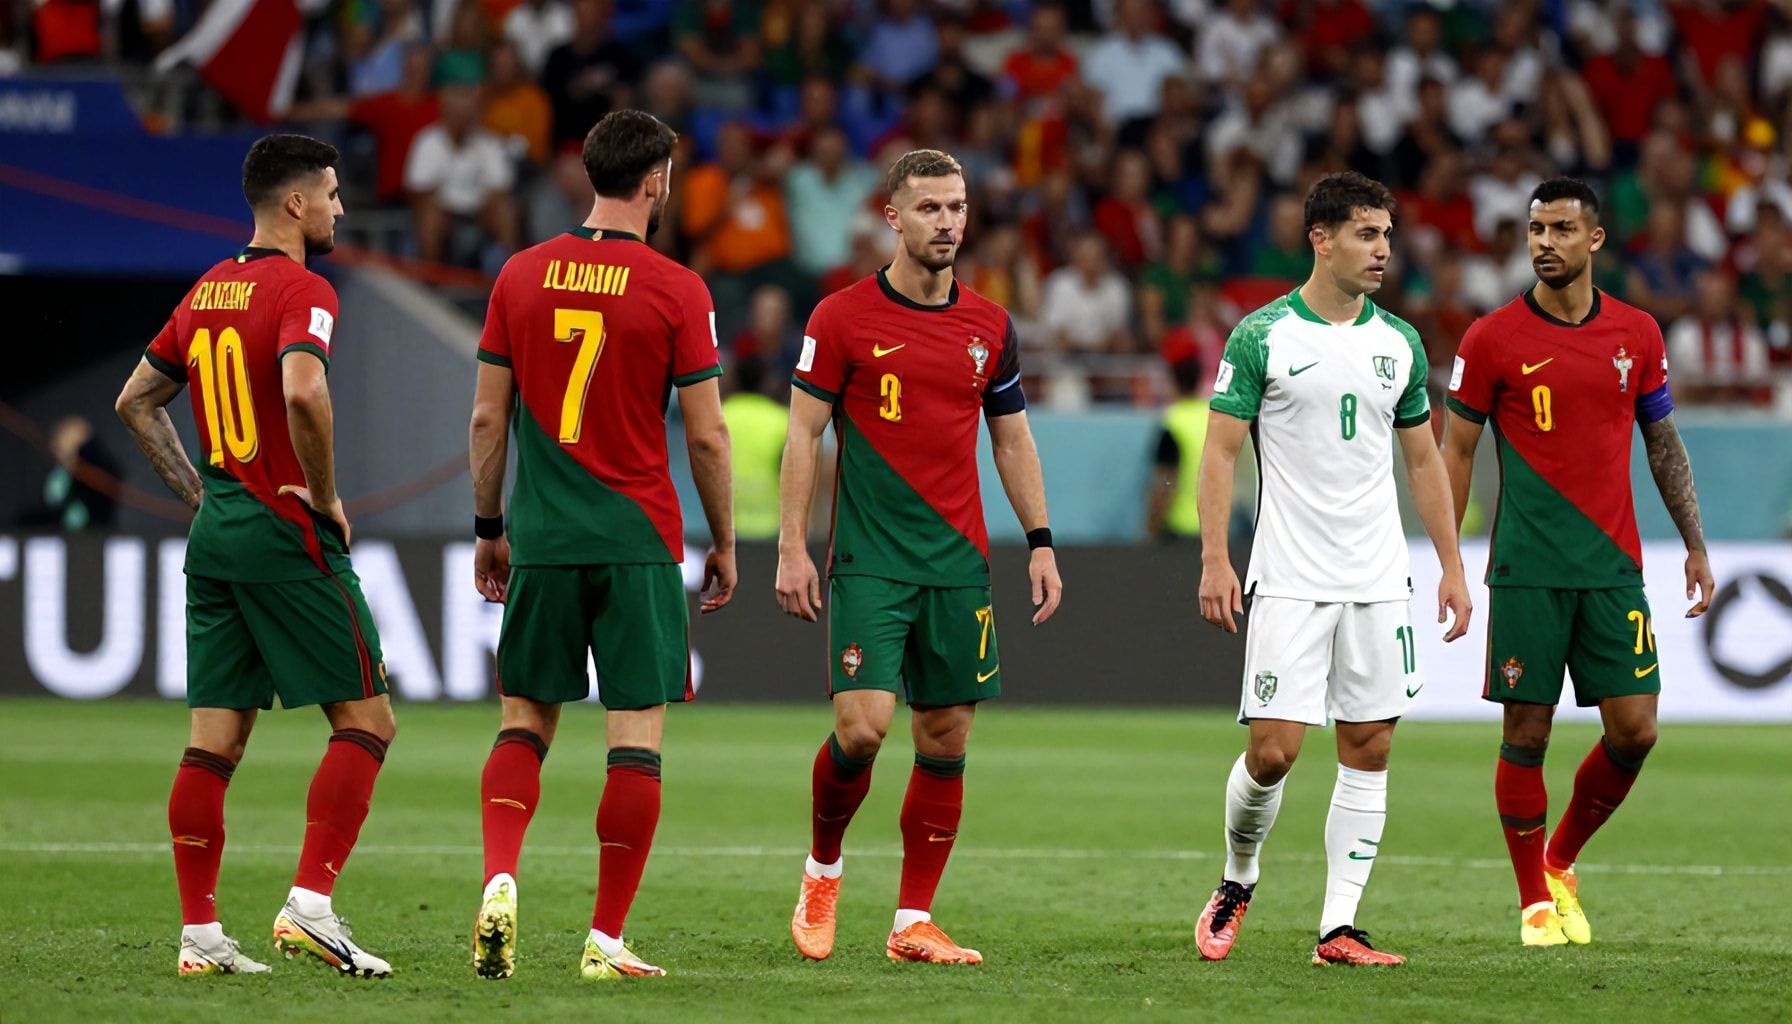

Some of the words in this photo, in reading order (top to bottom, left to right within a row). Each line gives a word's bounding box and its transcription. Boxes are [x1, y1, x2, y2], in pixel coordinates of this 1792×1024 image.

[187, 327, 258, 468] 10
[554, 308, 606, 444] 7
[1340, 393, 1357, 441] 8
[1395, 625, 1415, 675] 11
